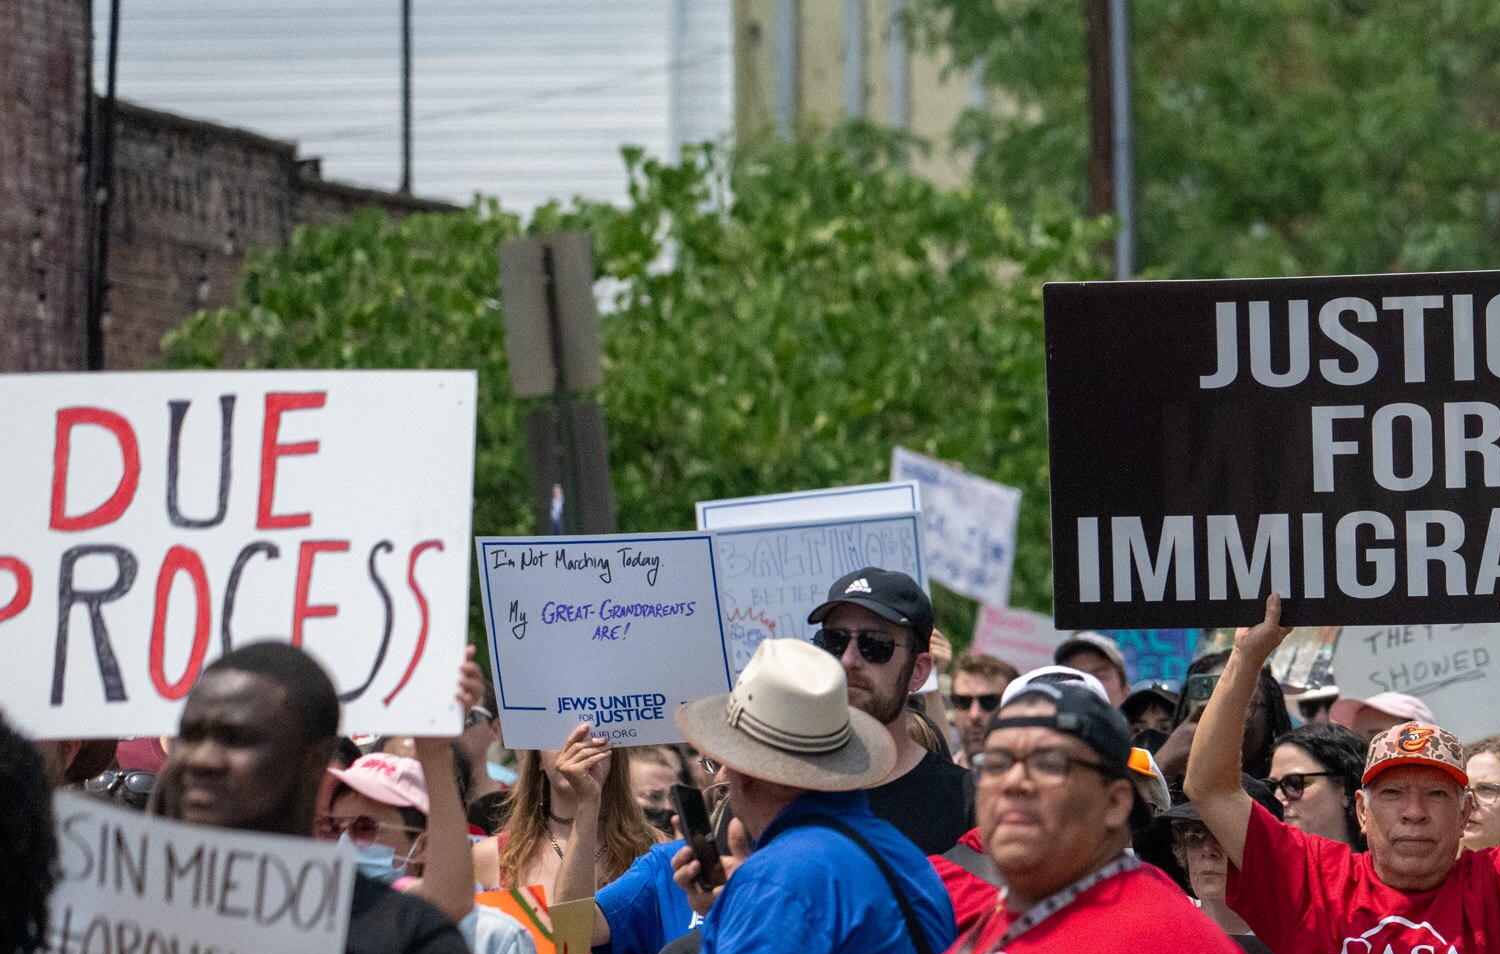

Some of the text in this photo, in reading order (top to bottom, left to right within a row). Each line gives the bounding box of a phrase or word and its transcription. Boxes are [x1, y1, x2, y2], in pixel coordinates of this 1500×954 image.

[49, 390, 328, 530] DUE
[521, 547, 549, 570] Not
[555, 548, 612, 583] Marching
[509, 600, 528, 640] My
[592, 622, 632, 641] ARE!
[1368, 645, 1491, 693] SHOWED
[557, 693, 667, 714] JEWS UNITED
[578, 707, 665, 728] FOR JUSTICE
[61, 809, 147, 898] SIN
